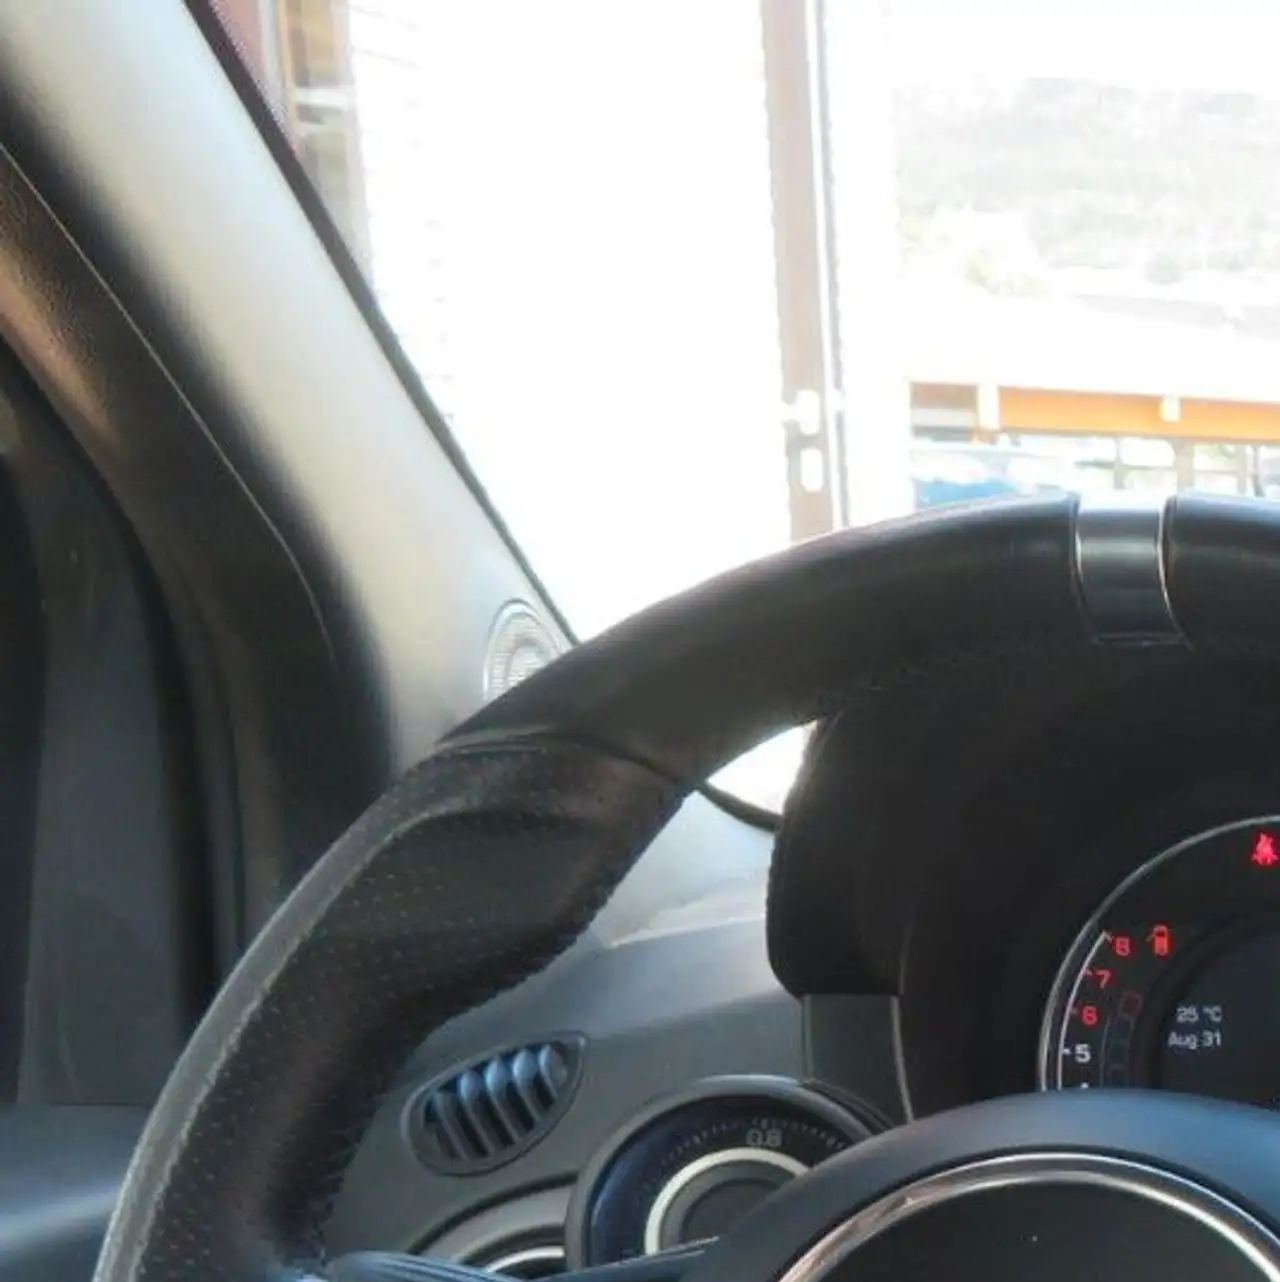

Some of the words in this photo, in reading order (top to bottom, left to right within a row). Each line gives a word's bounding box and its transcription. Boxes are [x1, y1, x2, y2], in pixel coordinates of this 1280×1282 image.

[1114, 936, 1131, 957] 8
[1095, 969, 1112, 988] 7
[1081, 1006, 1098, 1025] 6
[1167, 1031, 1198, 1050] Aug
[1202, 1030, 1222, 1047] 31
[1074, 1043, 1091, 1063] 5
